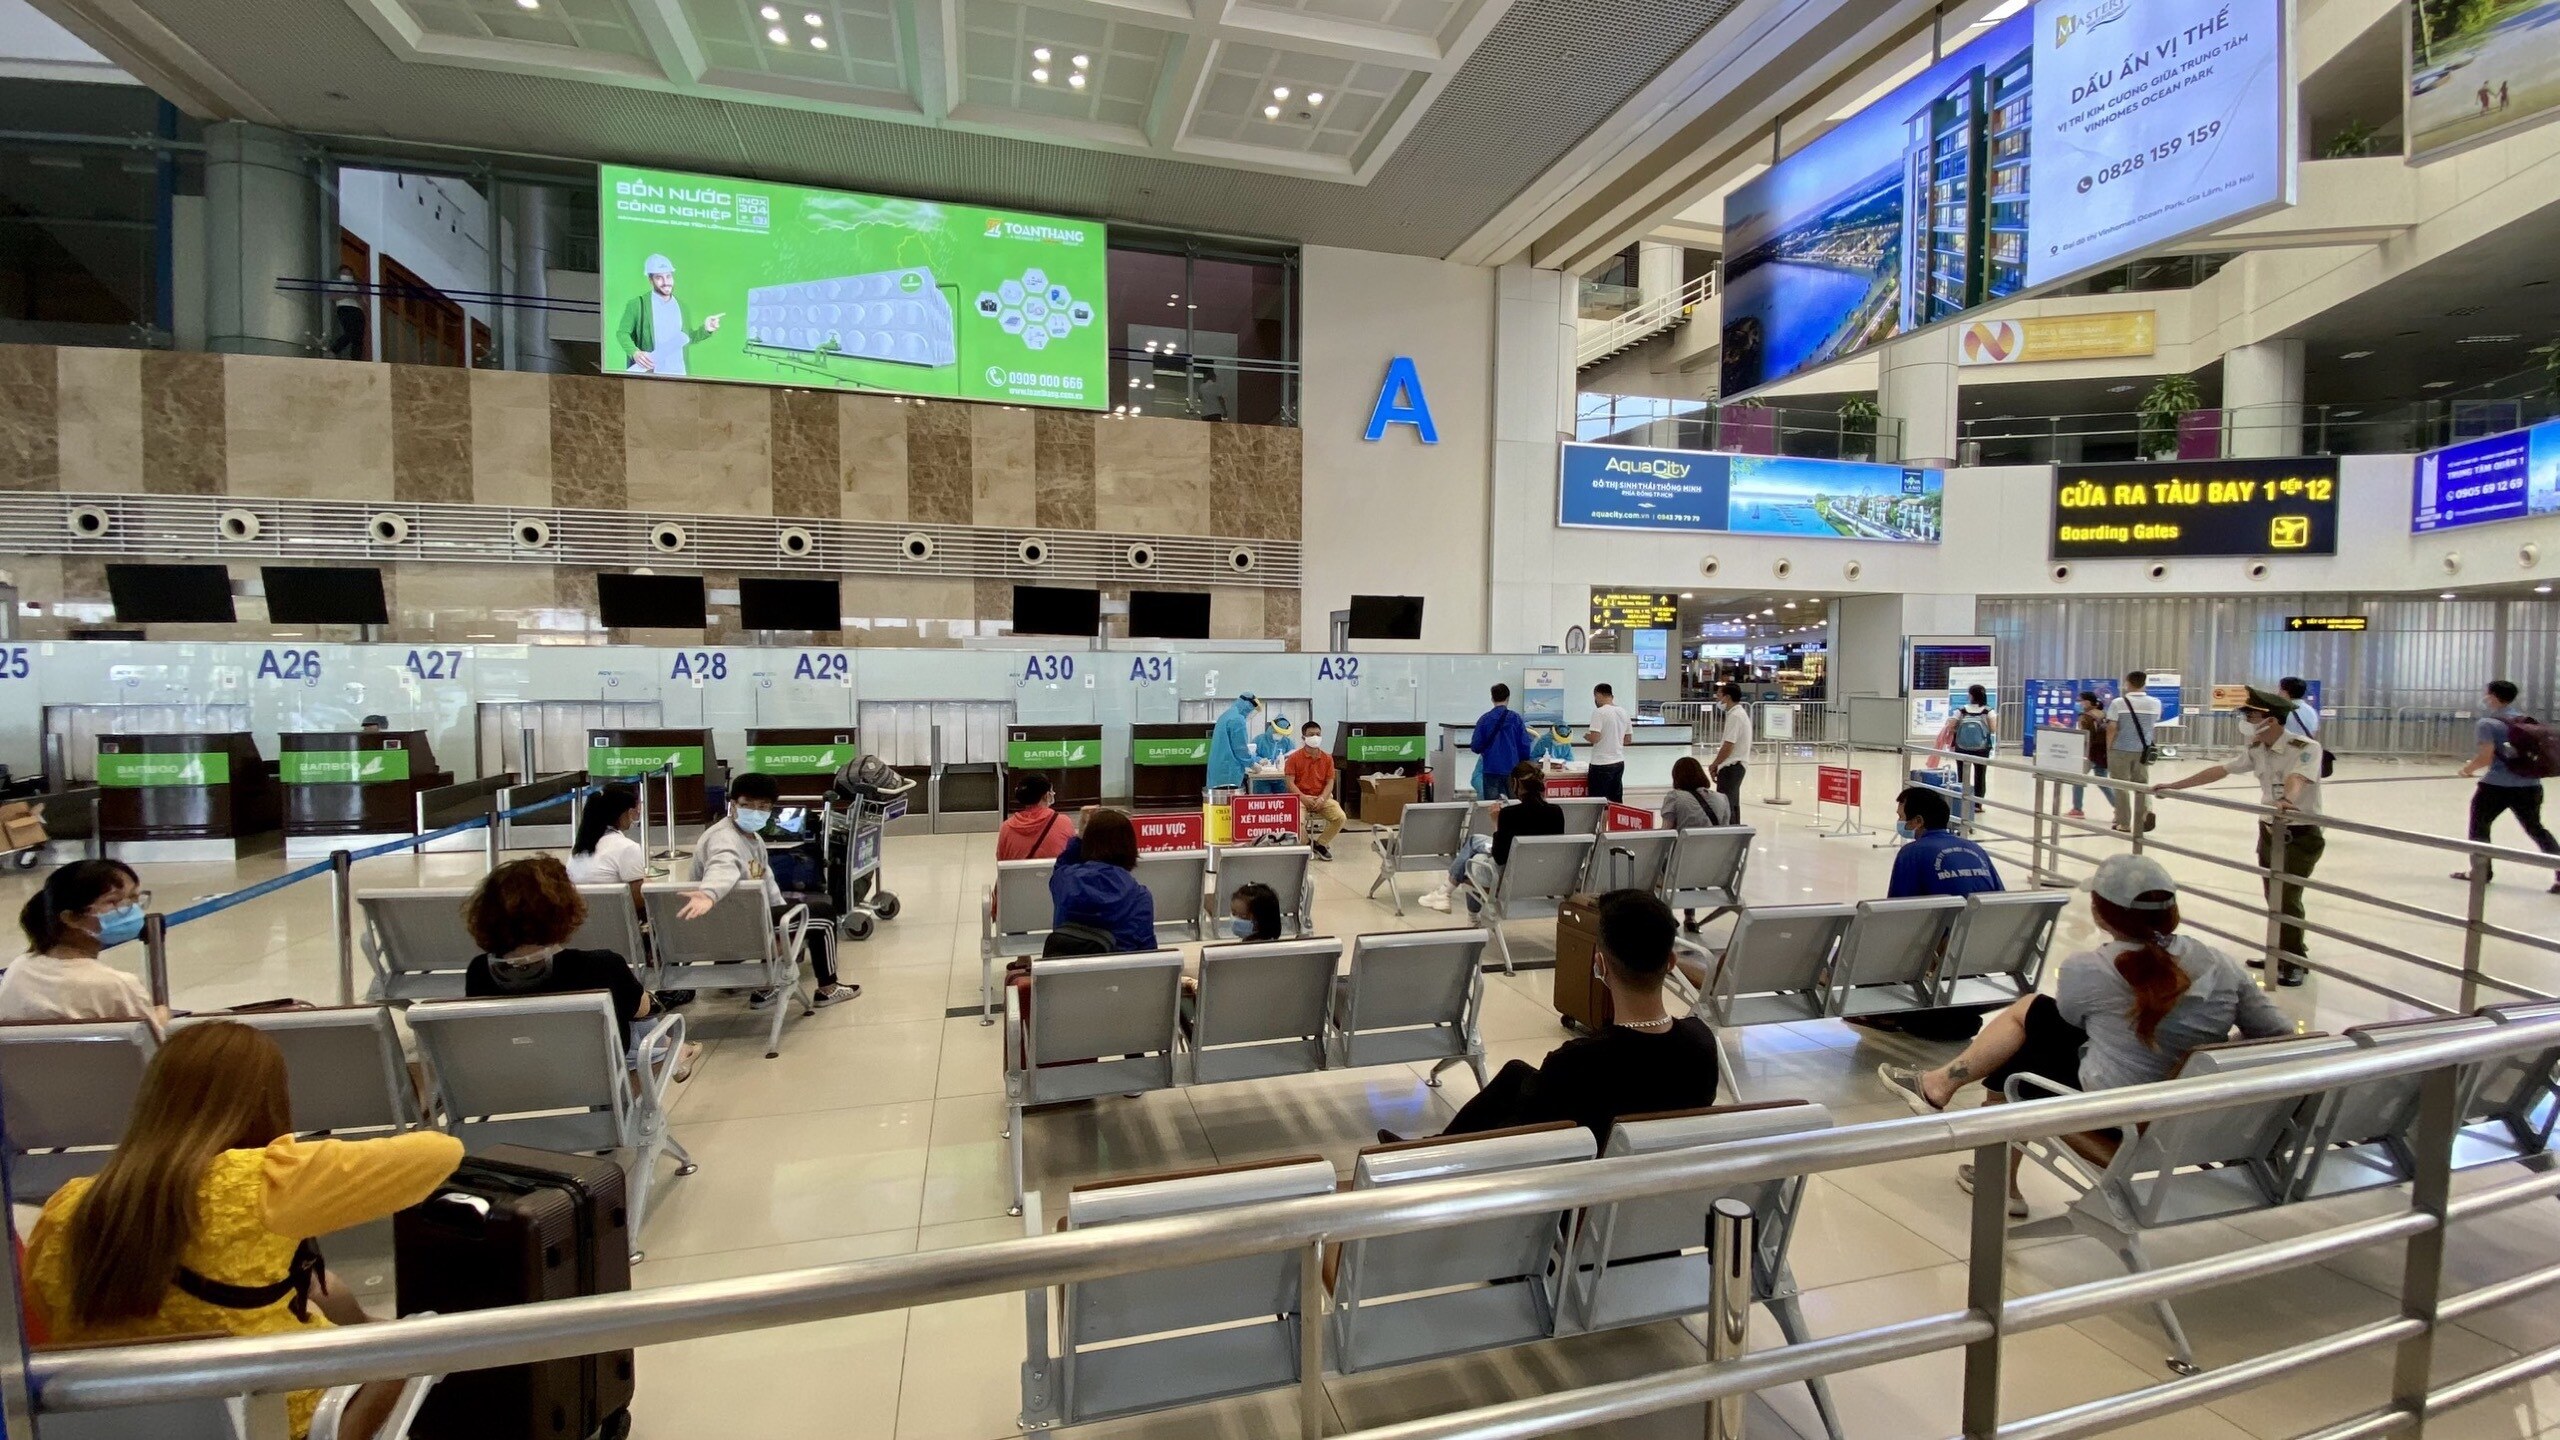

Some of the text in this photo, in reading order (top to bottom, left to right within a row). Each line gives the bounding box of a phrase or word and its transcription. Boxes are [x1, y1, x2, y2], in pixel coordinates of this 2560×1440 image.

[2072, 3, 2230, 105] DẤU ẤN VỊ THẾ
[2057, 120, 2067, 133] VỊ
[2069, 111, 2086, 128] TRÍ
[2086, 103, 2105, 120] KIM
[2179, 46, 2222, 73] TRUNG
[2223, 32, 2249, 52] TÂM
[2084, 65, 2215, 134] VINHOMES OCEAN PARK
[2098, 120, 2222, 185] 0828 159 159
[669, 187, 731, 206] NƯỚC
[738, 197, 767, 206] INOX
[617, 199, 667, 214] CÔNG
[669, 206, 731, 222] NGHIỆP
[739, 204, 768, 215] 304
[1004, 222, 1084, 242] TOANTHANG
[2098, 217, 2137, 238] Vinhomes
[2137, 207, 2163, 222] Ocean
[1008, 372, 1084, 390] 0909 000 666
[1364, 355, 1440, 444] A
[1605, 457, 1691, 478] AquaCity
[1619, 482, 1637, 490] SINH
[1638, 482, 1656, 491] THÁI
[1682, 485, 1702, 493] MINH
[2061, 480, 2107, 507] CỬA
[2114, 485, 2147, 505] RA
[2154, 479, 2200, 504] TÀU
[2208, 481, 2255, 503] BAY
[2263, 481, 2276, 501] 1
[2304, 479, 2332, 501] 12
[2455, 478, 2524, 499] 0905 69 12 69
[2060, 524, 2179, 542] Boarding Gates
[257, 650, 321, 679] A26
[406, 650, 463, 679] A27
[671, 652, 728, 680] A28
[794, 653, 848, 680] A29
[1024, 655, 1074, 680] A30
[1130, 656, 1174, 681] A31
[1318, 657, 1359, 680] A32
[765, 755, 817, 764] BAMBOO
[1024, 750, 1070, 758] BAMBOO
[1149, 747, 1192, 755] BAMBOO
[117, 766, 179, 774] BAMBOO
[300, 762, 361, 771] BAMBOO
[607, 757, 662, 766] BAMBOO
[1547, 787, 1559, 797] KHU
[1248, 800, 1285, 811] KHU VỰC
[1240, 814, 1256, 824] XÉT
[1258, 813, 1292, 824] NGHIỆM
[1617, 813, 1629, 826] KHU
[1141, 822, 1186, 838] KHU VỰC
